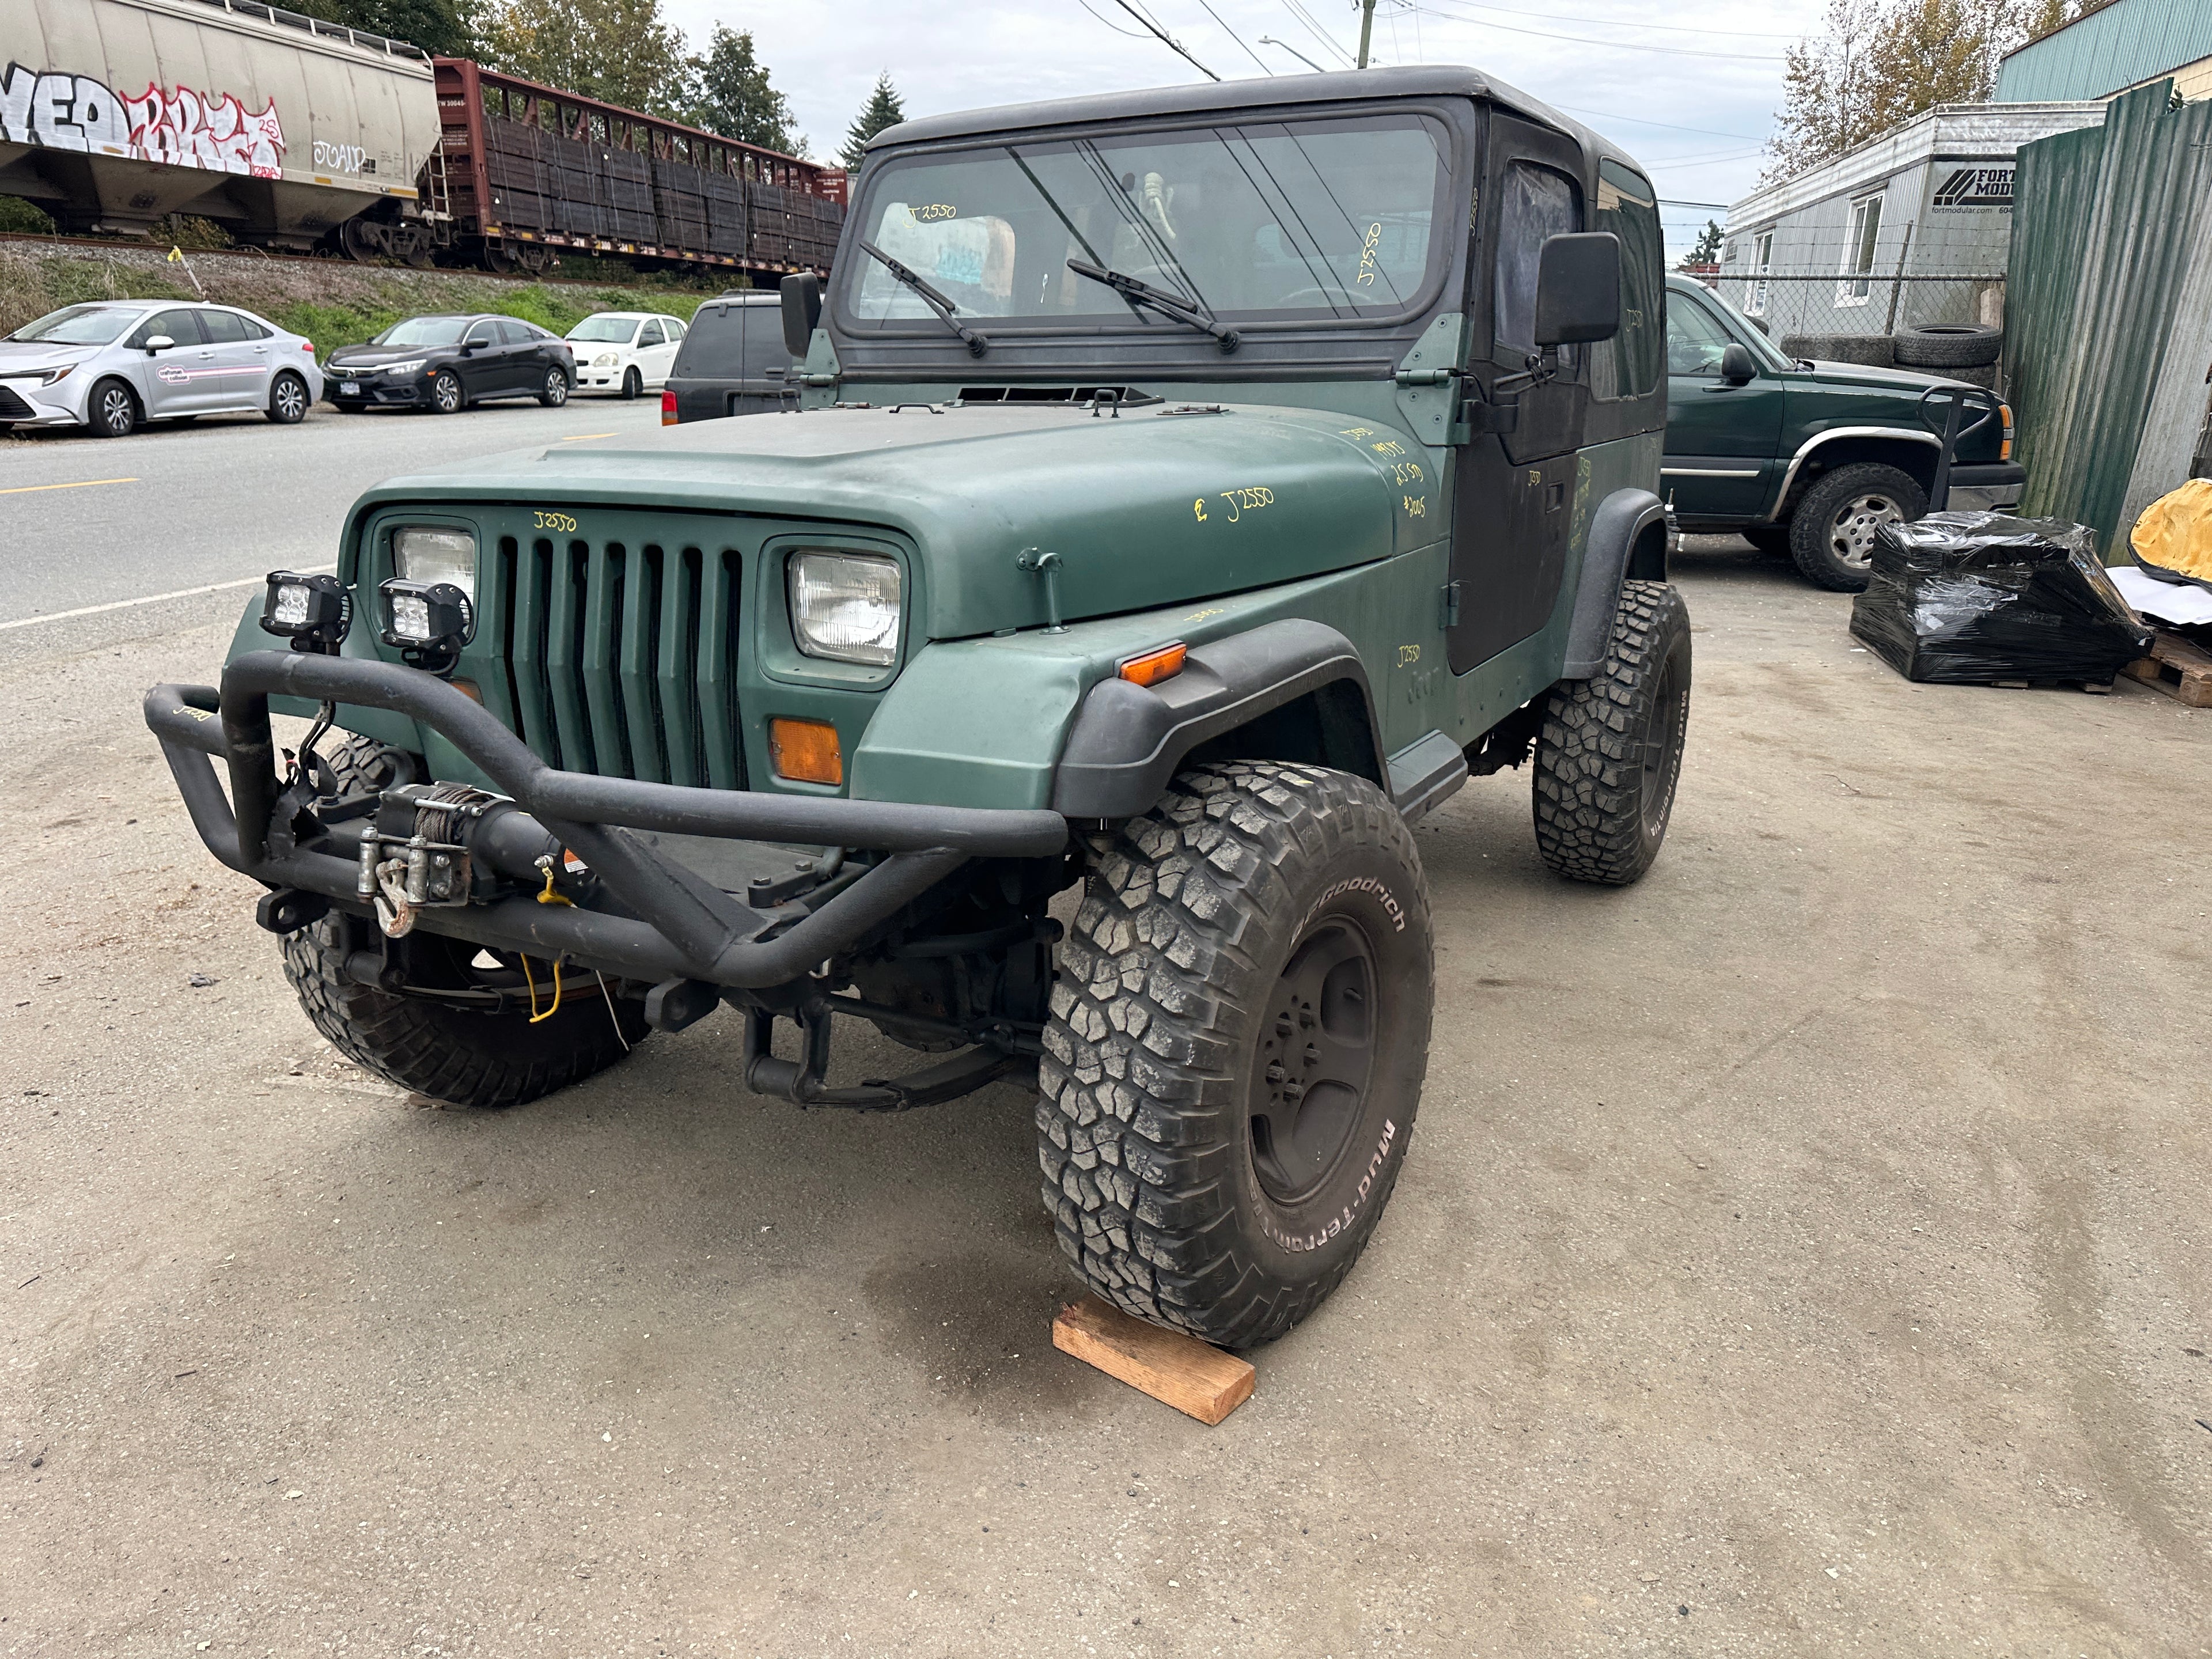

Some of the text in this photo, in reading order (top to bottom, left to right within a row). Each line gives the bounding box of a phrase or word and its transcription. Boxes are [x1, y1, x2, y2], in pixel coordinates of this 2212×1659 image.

[1977, 169, 2016, 182] FORT
[903, 204, 956, 228] J2550
[1358, 222, 1381, 286] J2550
[1221, 487, 1274, 522] J2550
[534, 511, 577, 532] J2550
[1397, 644, 1421, 668] J2550
